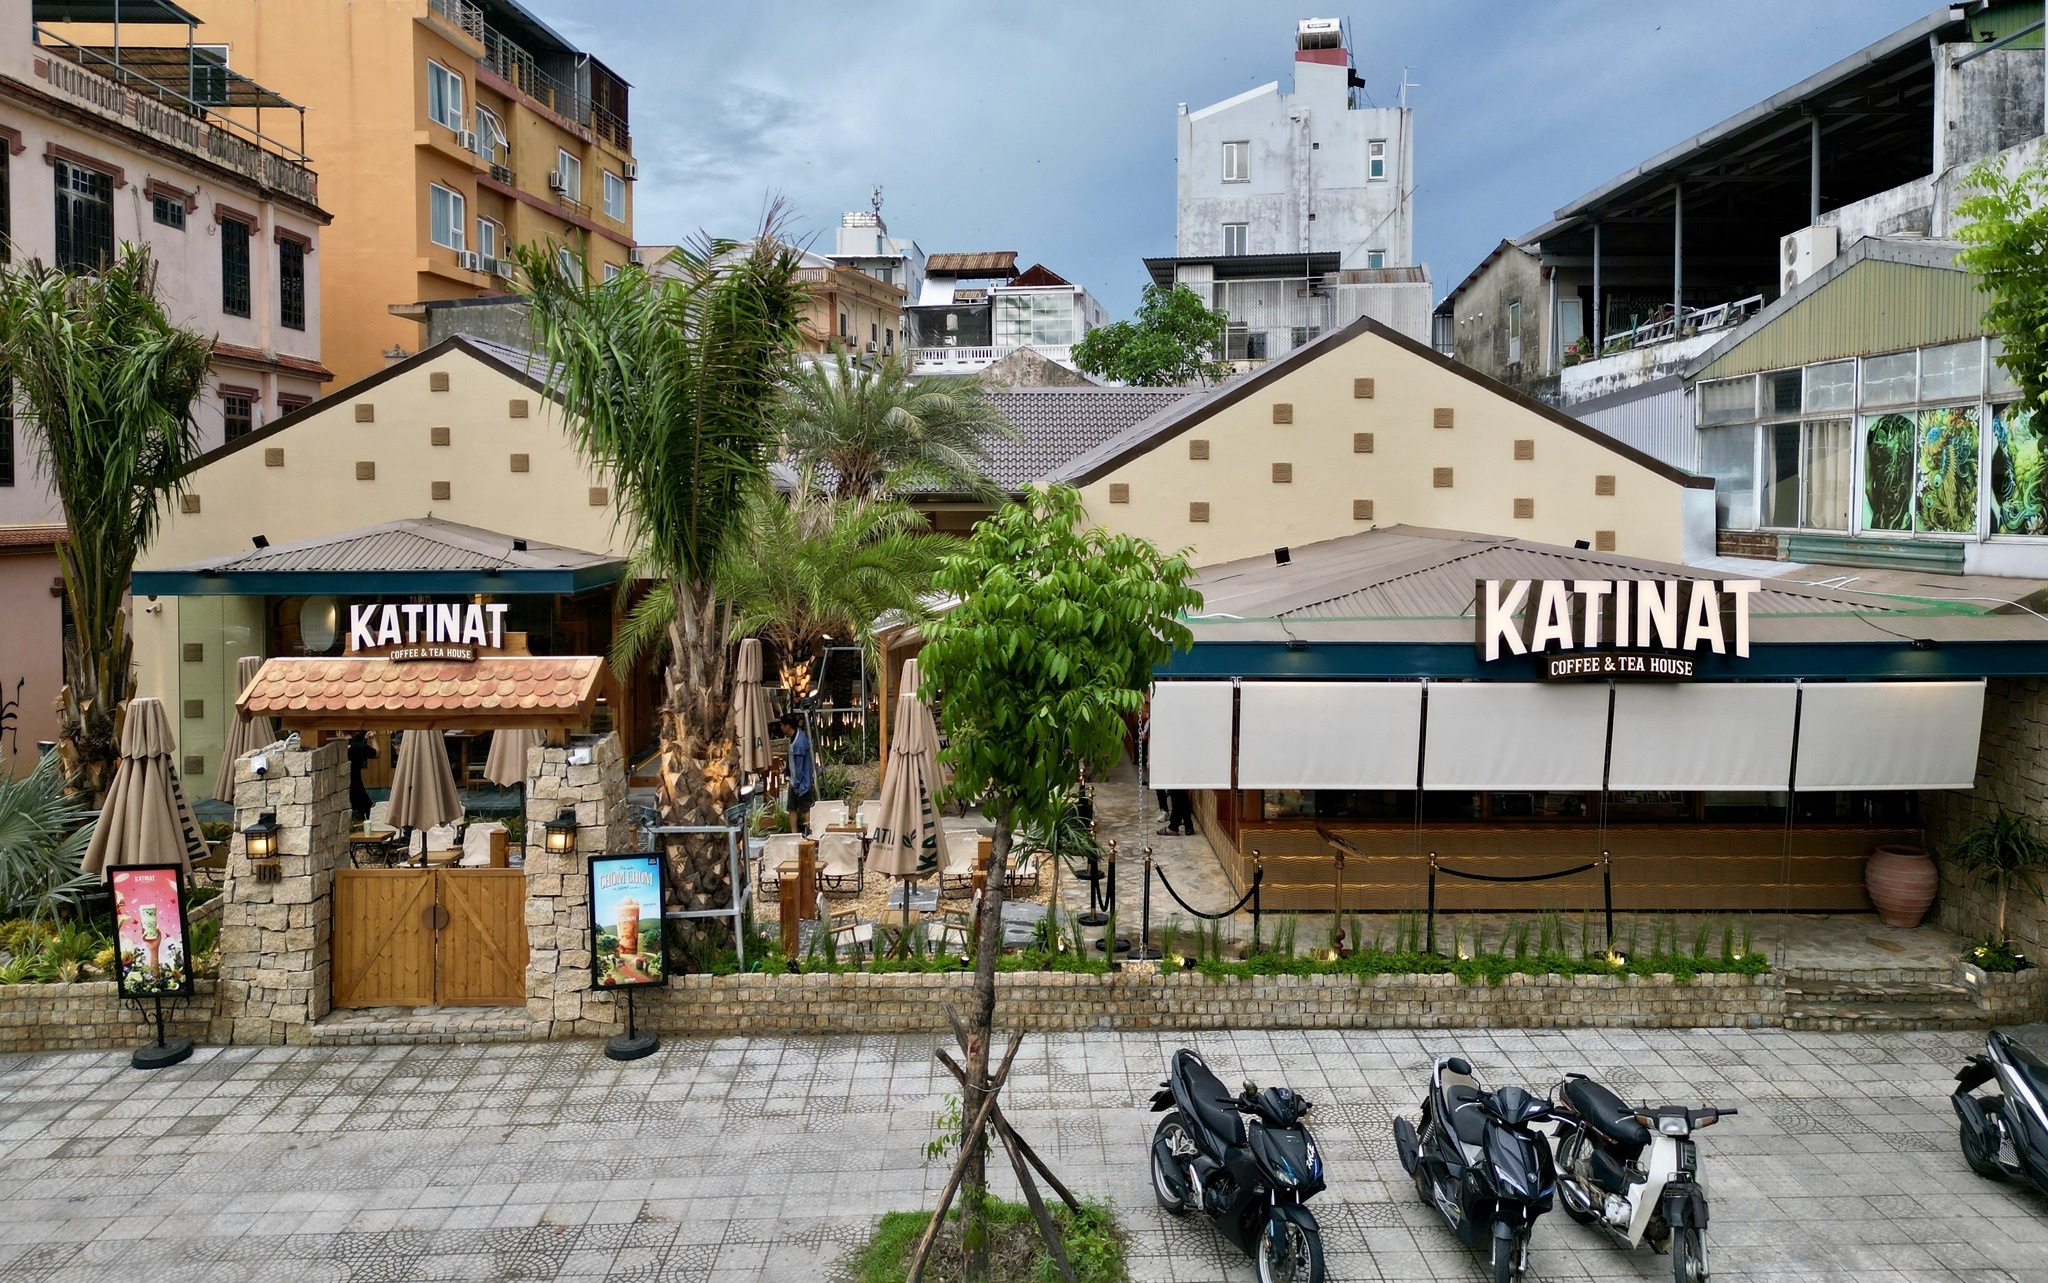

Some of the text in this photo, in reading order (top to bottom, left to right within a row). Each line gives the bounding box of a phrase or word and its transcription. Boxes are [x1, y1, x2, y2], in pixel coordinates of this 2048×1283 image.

[350, 603, 508, 651] KATINAT
[1485, 579, 1761, 662] KATINAT
[390, 648, 472, 660] COFFEE & TEA HOUSE
[1551, 656, 1693, 676] COFFEE & TEA HOUSE
